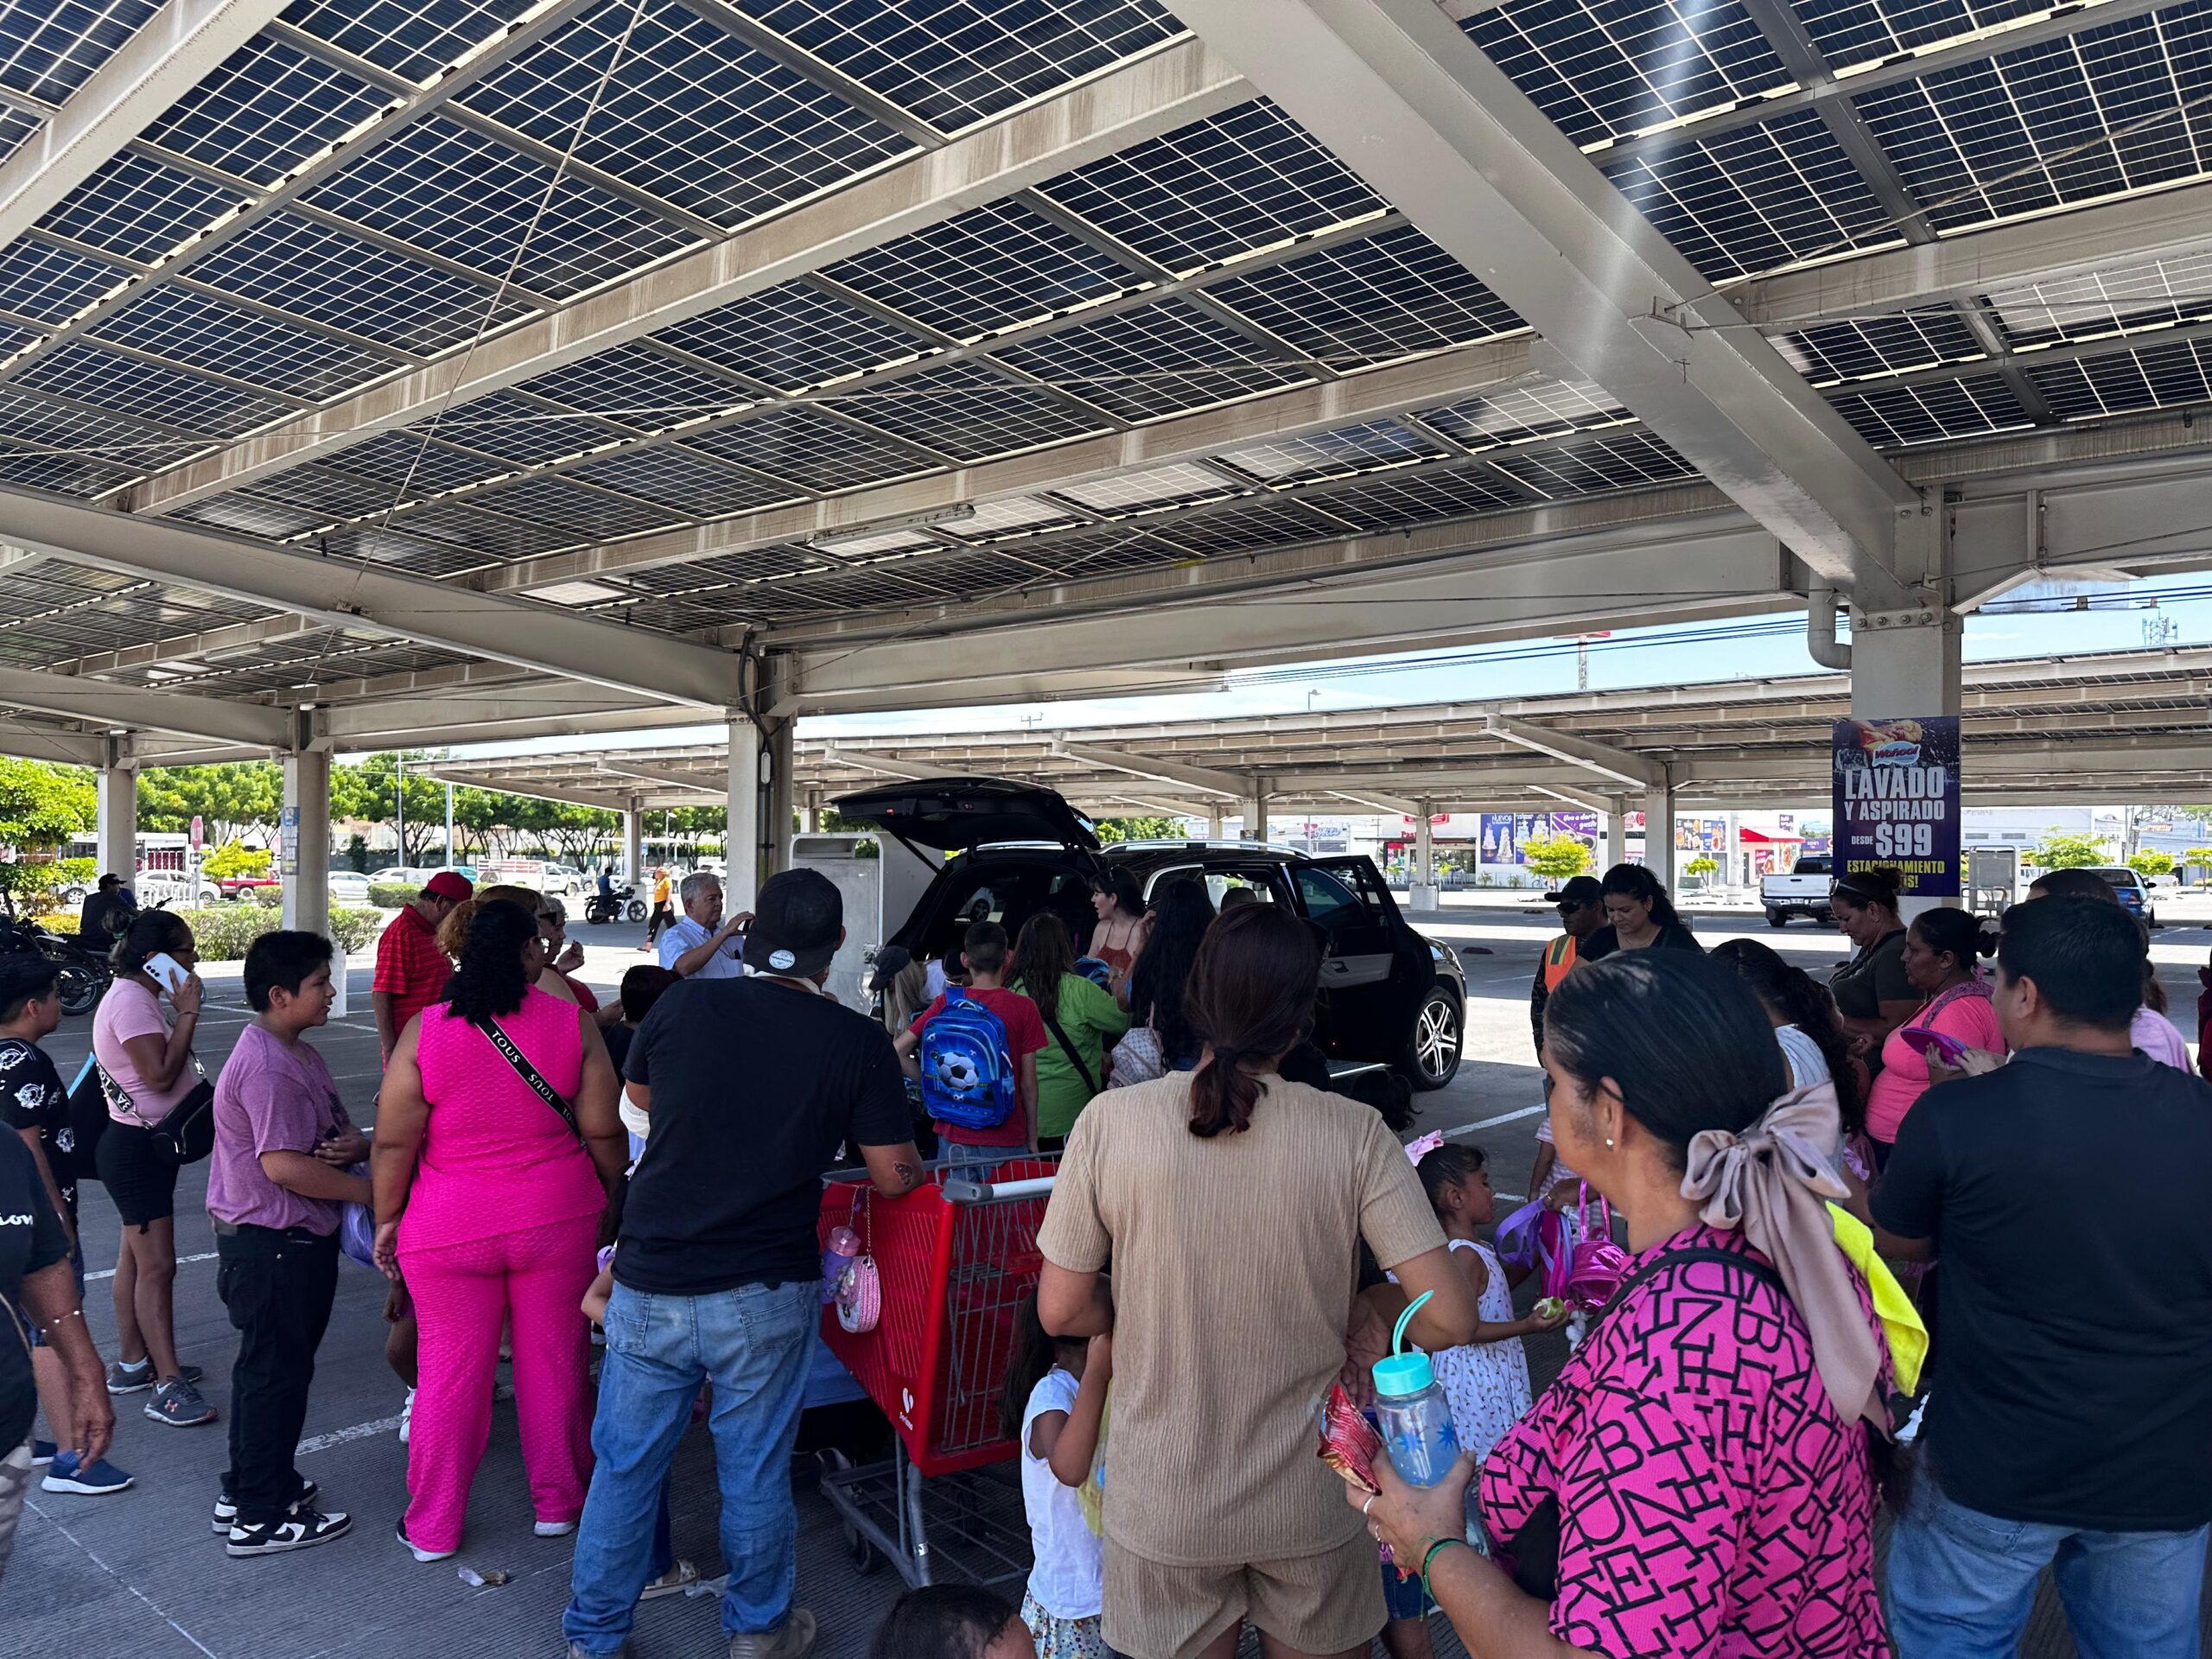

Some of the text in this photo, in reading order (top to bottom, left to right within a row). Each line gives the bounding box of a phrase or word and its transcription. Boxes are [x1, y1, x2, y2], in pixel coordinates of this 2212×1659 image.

[1845, 766, 1944, 799] LAVADO
[1844, 800, 1944, 821] Y ASPIRADO
[1851, 821, 1932, 858] DESDE $99
[492, 1030, 520, 1063] TOUS
[528, 1074, 554, 1102] TOUS
